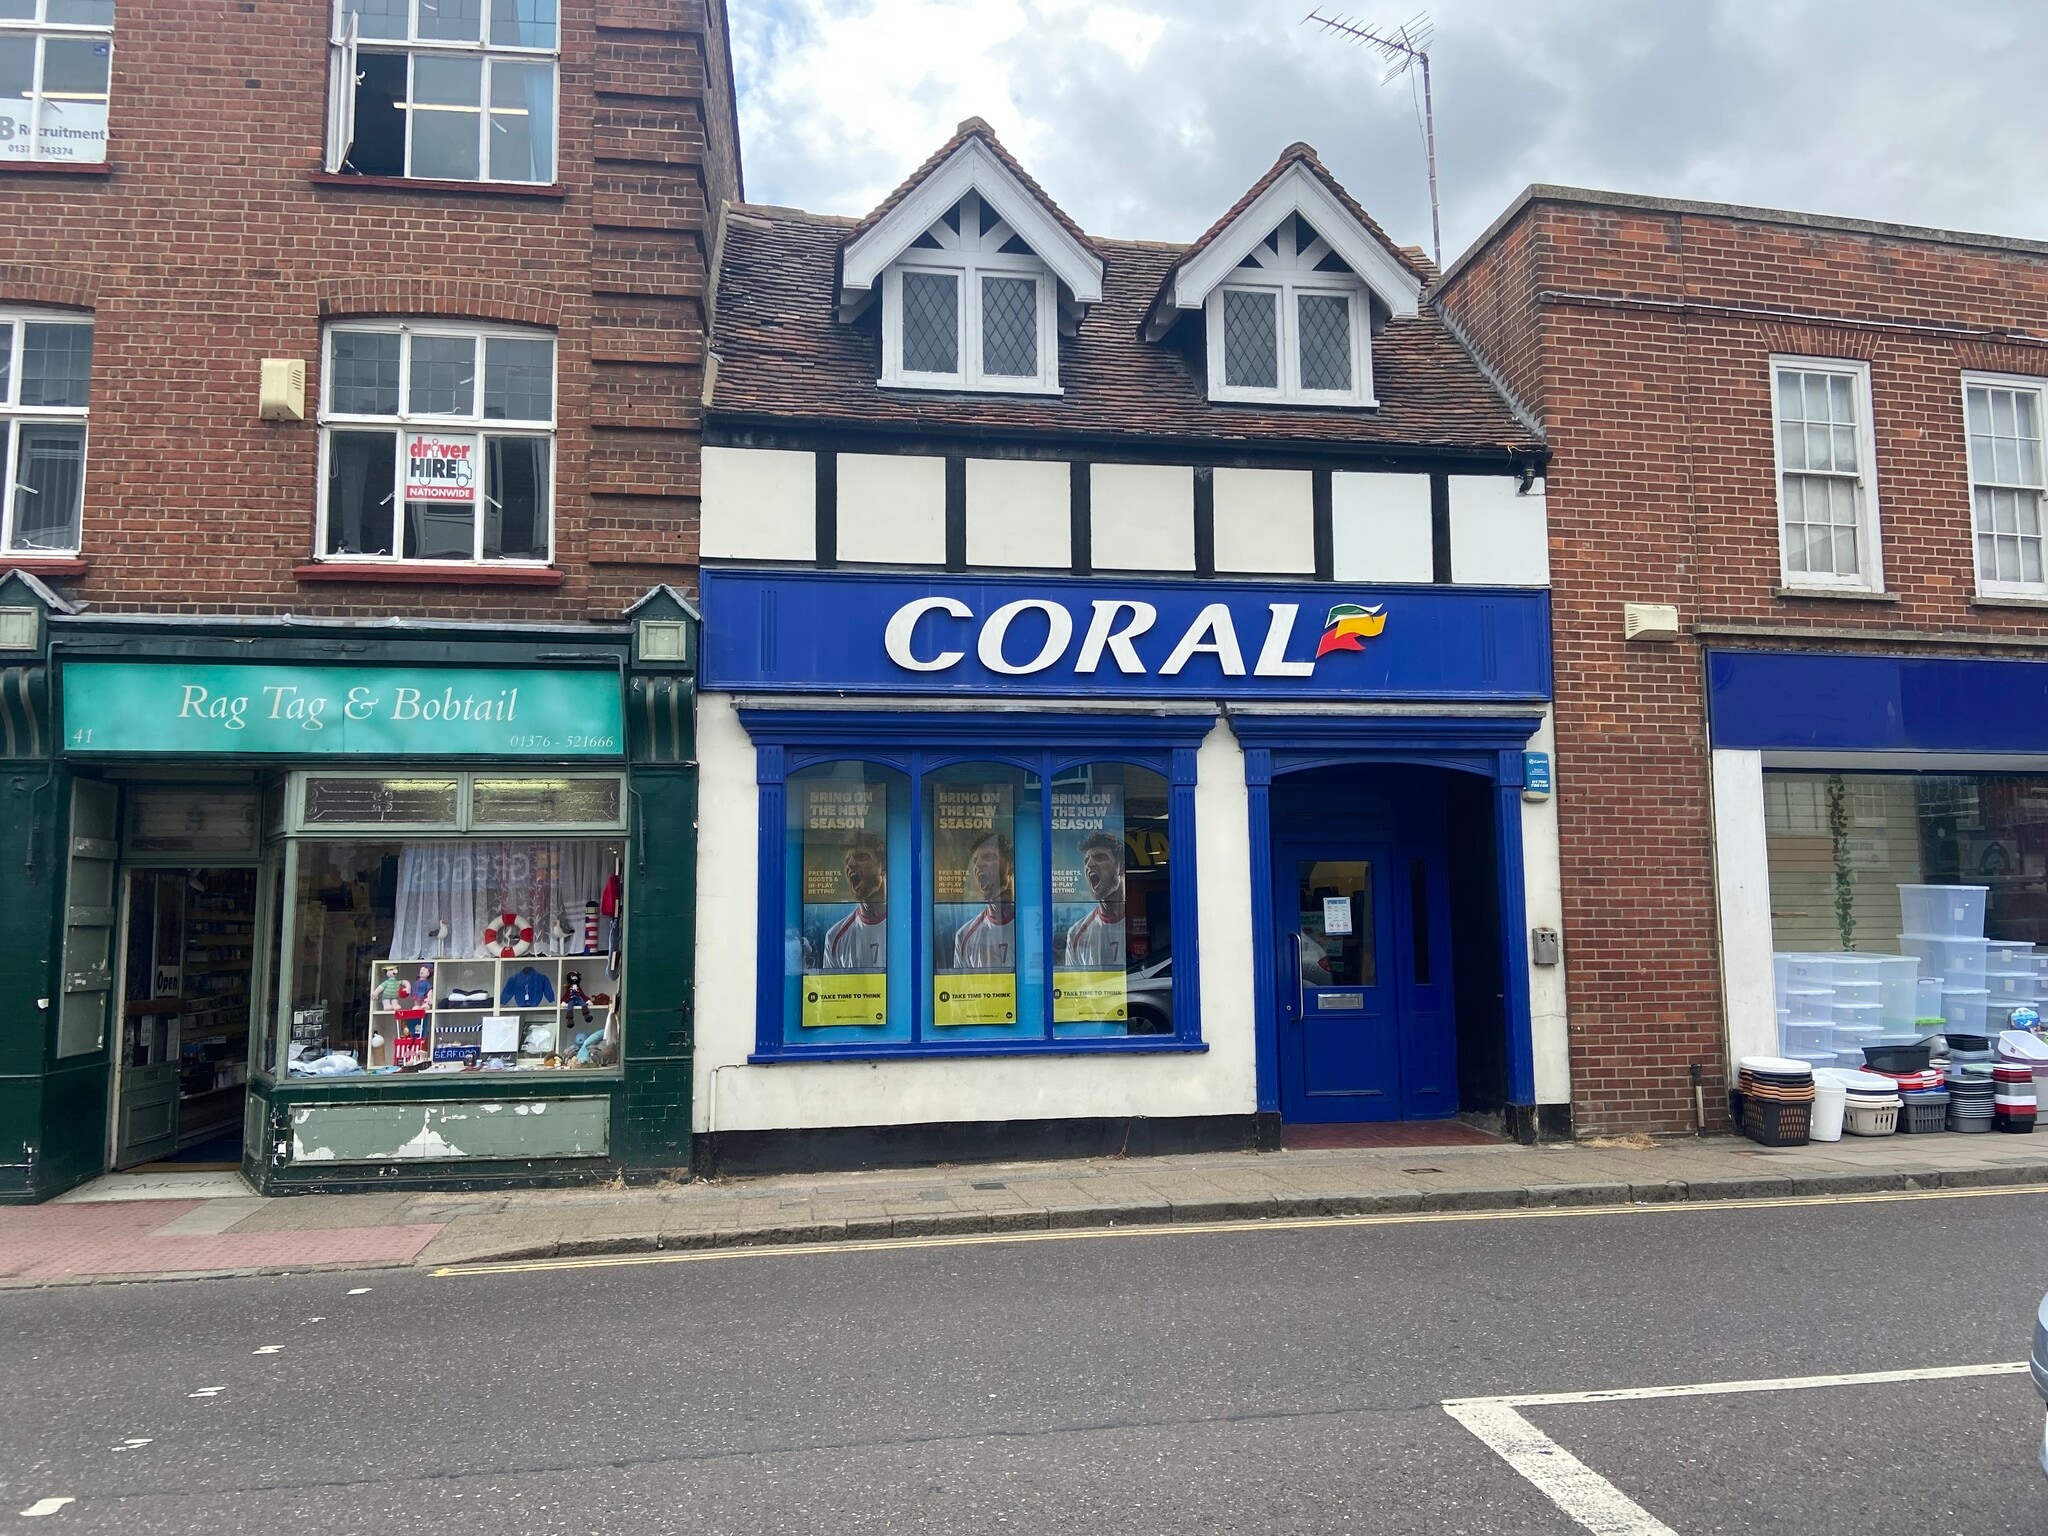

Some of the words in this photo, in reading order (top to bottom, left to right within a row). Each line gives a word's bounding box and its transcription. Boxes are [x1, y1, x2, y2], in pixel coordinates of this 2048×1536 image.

[19, 124, 105, 140] Rcruitment
[411, 458, 456, 478] HIRE
[410, 488, 470, 498] NATIONWIDE
[884, 596, 1316, 676] CORAL
[176, 685, 248, 730] Rag
[262, 686, 327, 730] Tag
[344, 686, 379, 720] &
[390, 686, 518, 721] Bobtail
[73, 728, 94, 744] 41
[510, 735, 551, 748] 01376
[564, 735, 614, 748] 521666
[810, 792, 852, 802] BRING
[854, 792, 872, 802] ON
[939, 792, 979, 803] BRING
[981, 792, 1000, 803] ON
[1051, 794, 1090, 804] BRING
[1092, 794, 1110, 804] ON
[810, 805, 836, 815] THE
[839, 805, 869, 815] NEW
[939, 805, 964, 816] THE
[966, 805, 996, 816] NEW
[1051, 806, 1075, 817] THE
[1078, 806, 1107, 817] NEW
[810, 818, 864, 828] SEASON
[939, 818, 992, 829] SEASON
[1051, 819, 1103, 830] SEASON
[870, 943, 879, 964] 7
[999, 943, 1008, 964] 7
[1110, 941, 1119, 961] 7
[158, 970, 178, 992] Open
